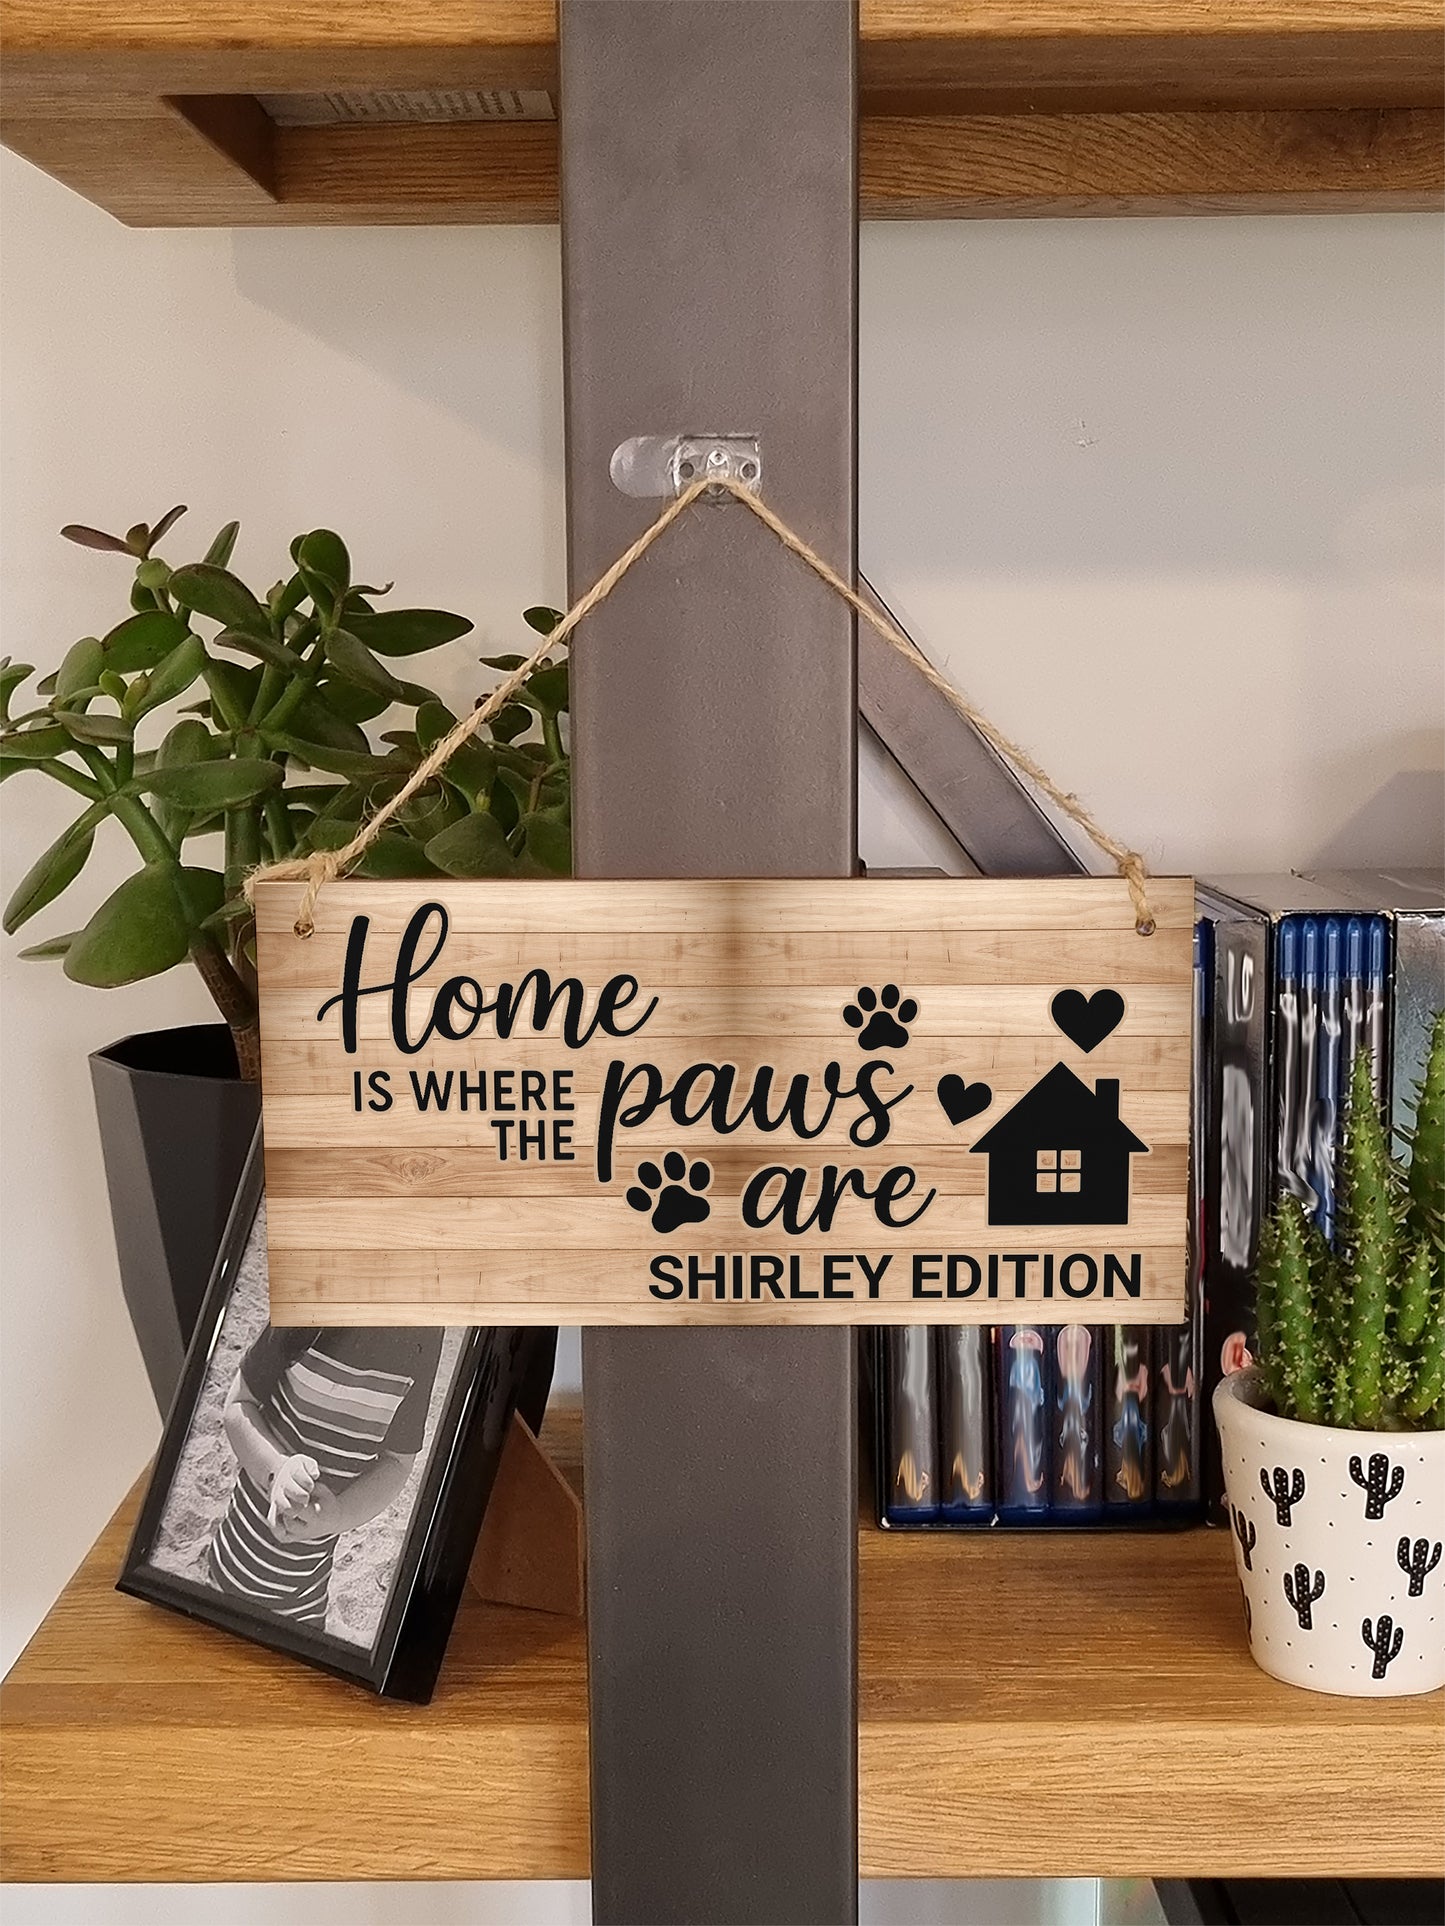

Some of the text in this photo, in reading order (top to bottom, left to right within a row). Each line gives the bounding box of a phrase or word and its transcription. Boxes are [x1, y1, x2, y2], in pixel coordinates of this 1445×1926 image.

[317, 903, 659, 1054] Home
[354, 1071, 574, 1112] IS WHERE
[491, 1120, 575, 1161] THE
[598, 1059, 914, 1182] paws
[743, 1165, 936, 1234] are
[649, 1254, 1141, 1299] SHIRLEY EDITION
